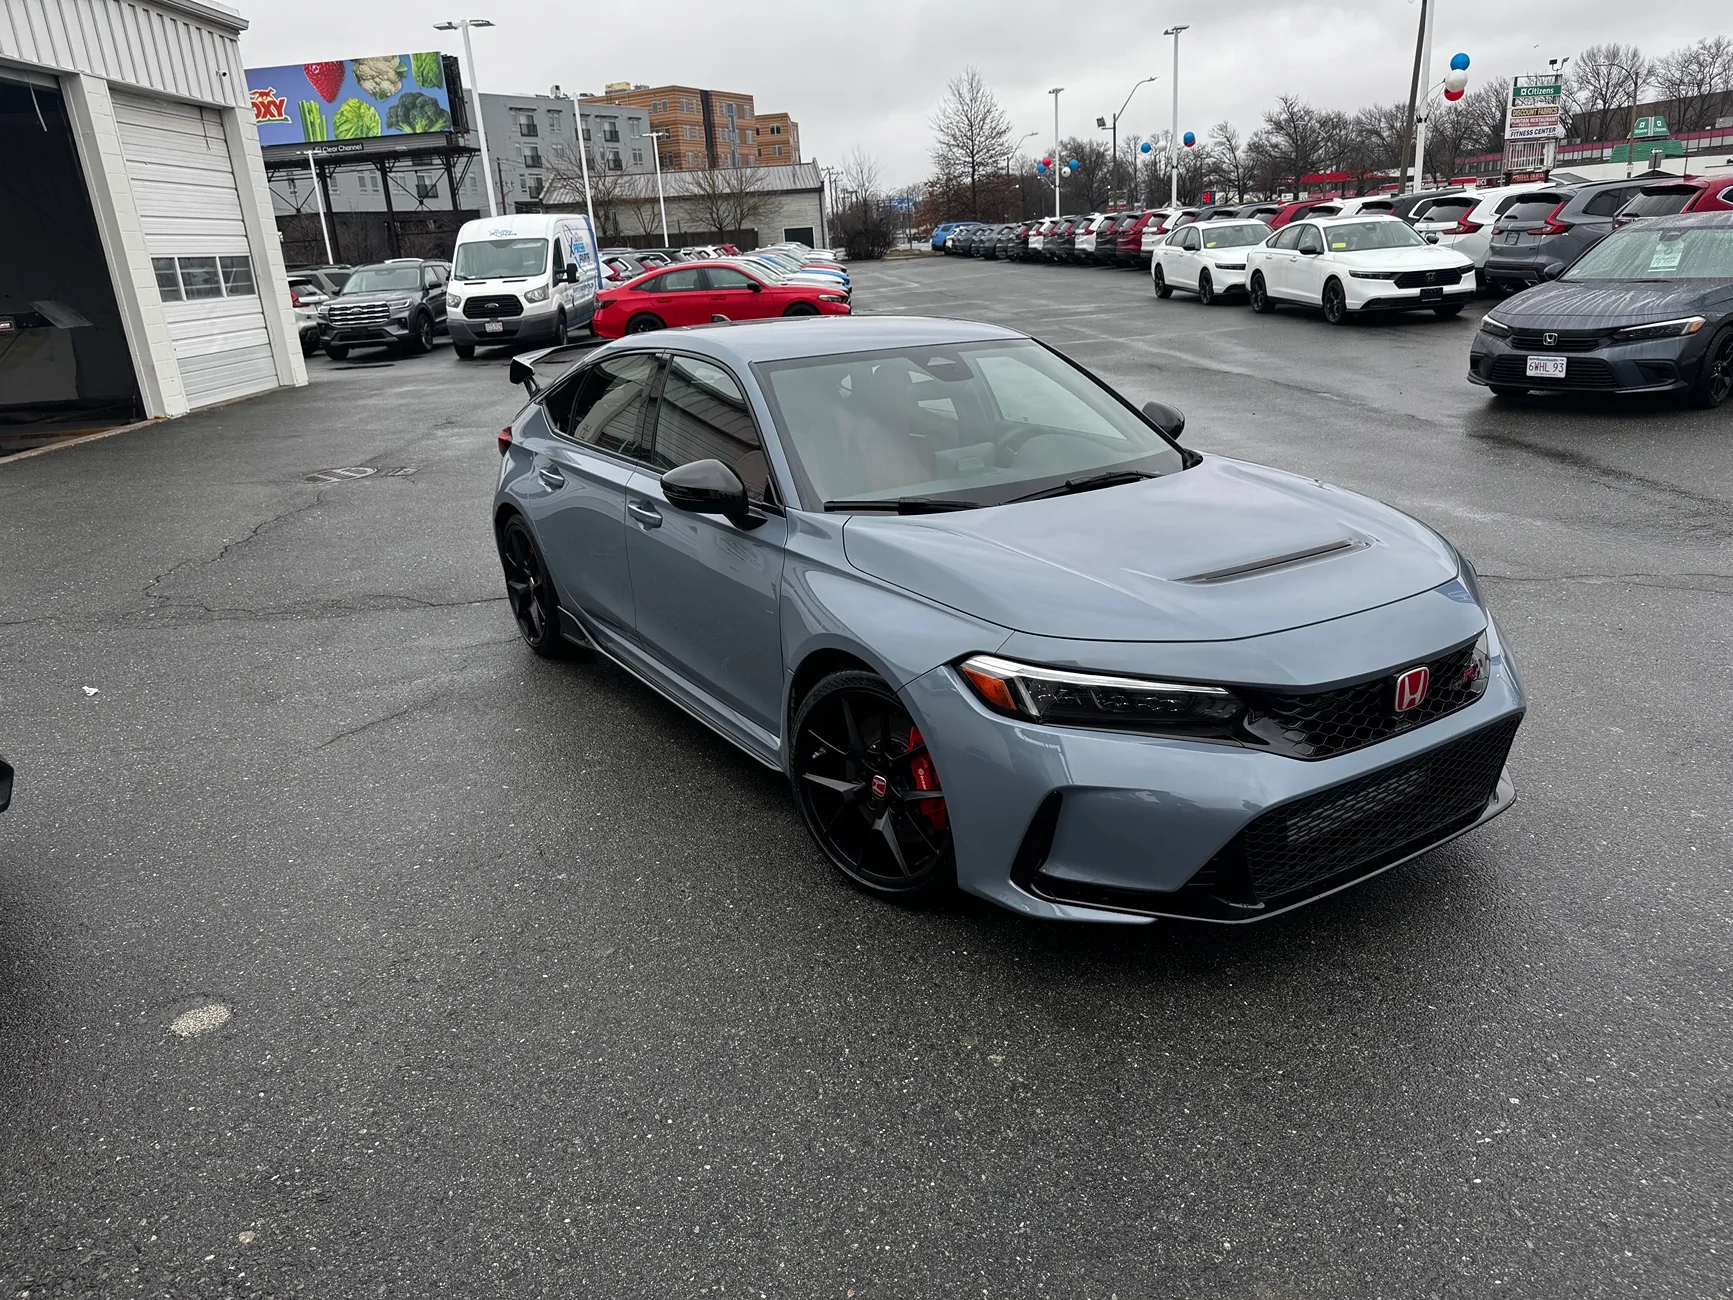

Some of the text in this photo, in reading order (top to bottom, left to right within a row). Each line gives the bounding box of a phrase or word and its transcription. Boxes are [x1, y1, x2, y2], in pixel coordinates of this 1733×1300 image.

[1527, 87, 1554, 95] Citizens
[1512, 107, 1558, 117] DISCOUNT FABRICS
[1534, 127, 1556, 135] CENTER
[338, 143, 362, 152] Channel
[1528, 362, 1564, 373] 6WHL 93
